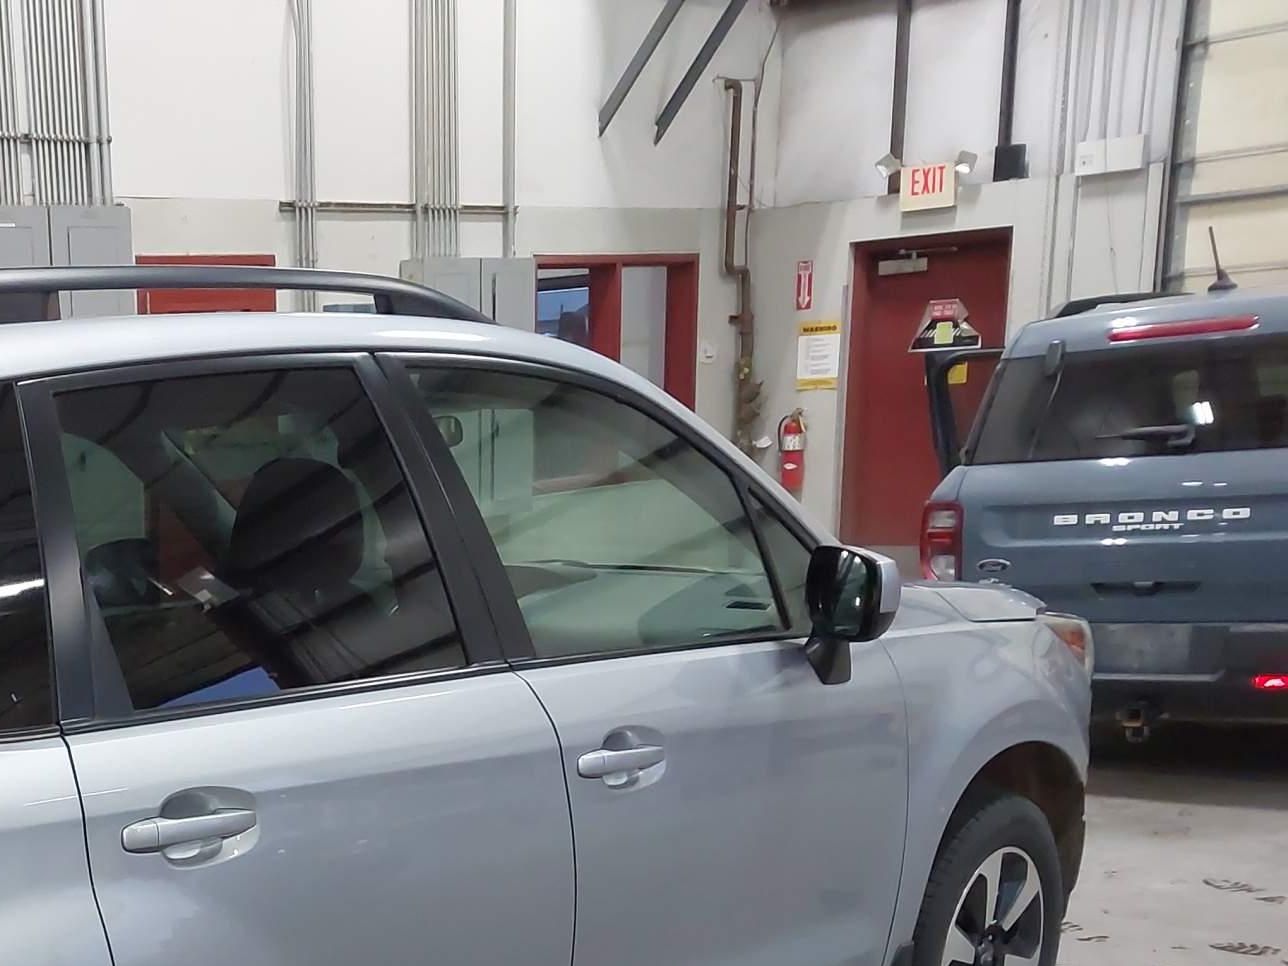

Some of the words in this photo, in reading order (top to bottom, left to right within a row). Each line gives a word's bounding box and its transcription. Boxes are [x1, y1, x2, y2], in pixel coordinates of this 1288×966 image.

[911, 165, 945, 196] EXIT
[1053, 507, 1251, 526] BRONCO
[1112, 522, 1184, 532] SPORT
